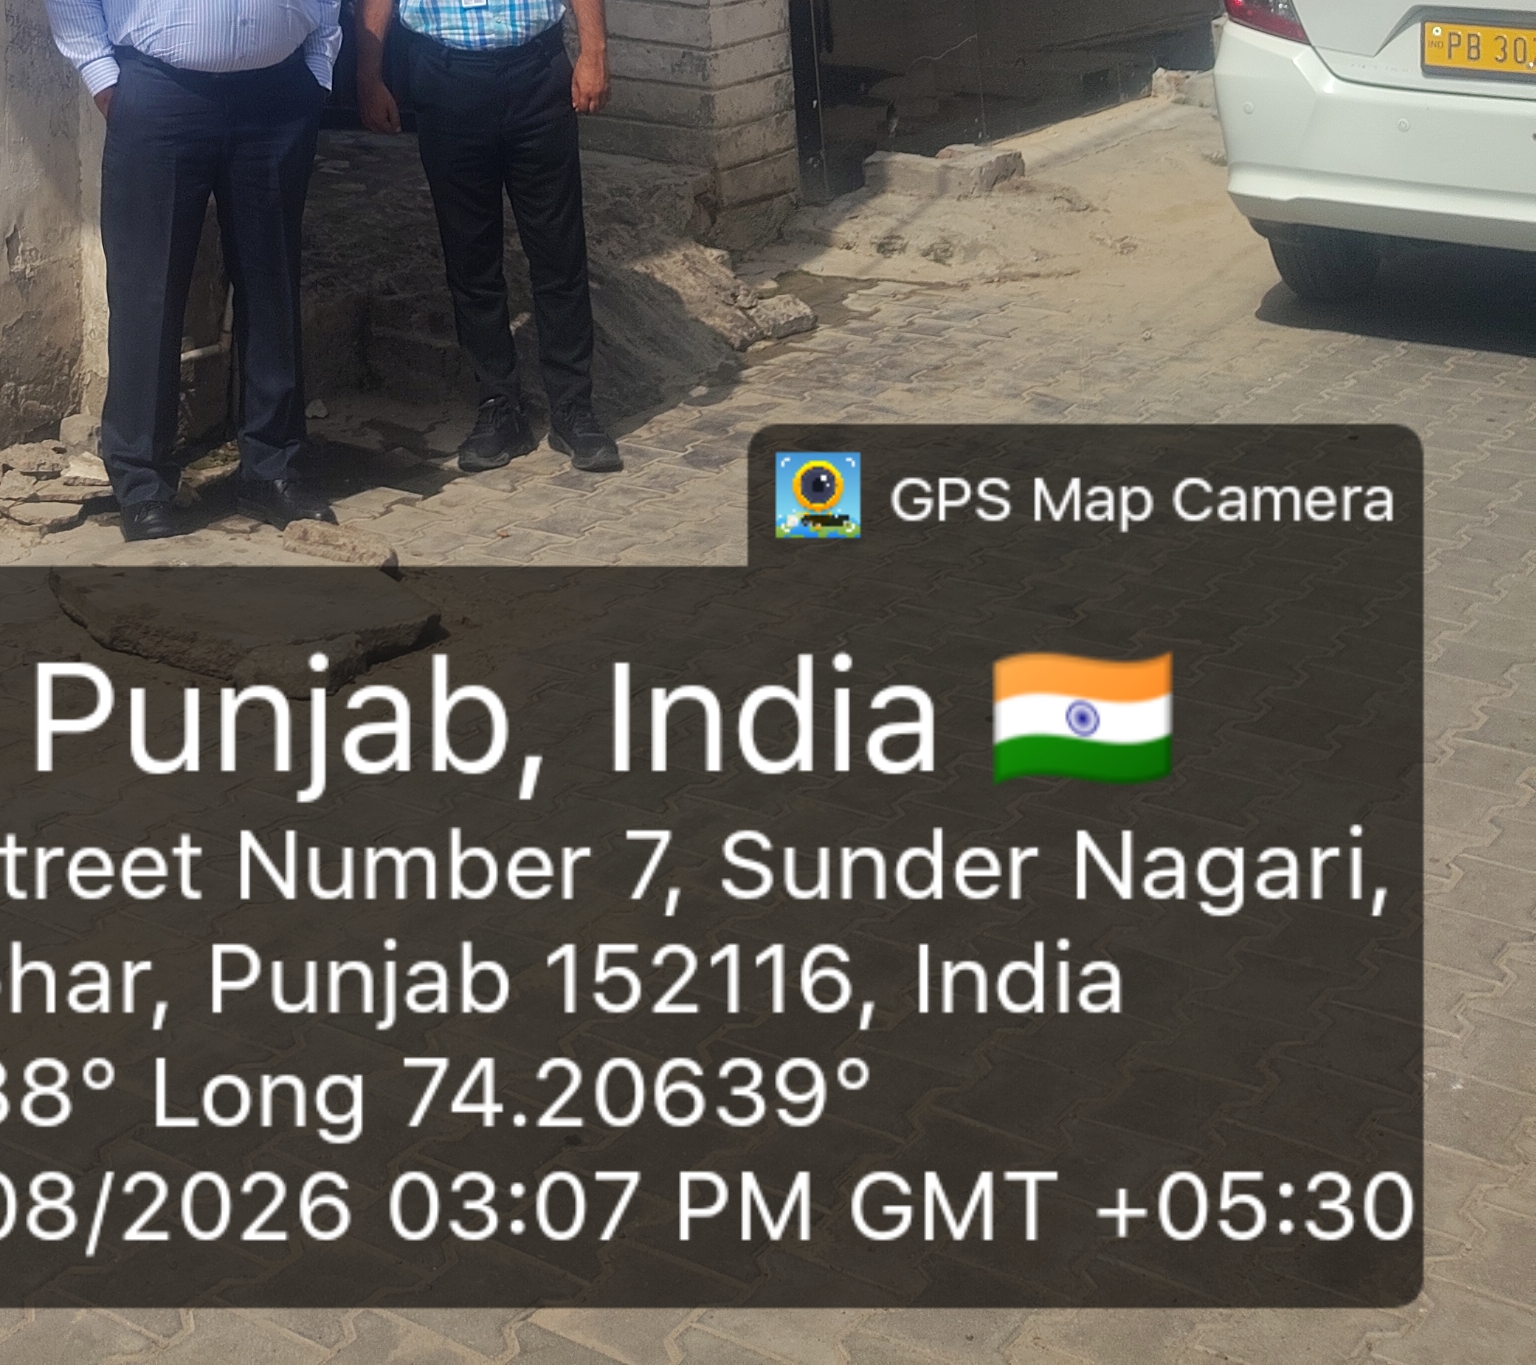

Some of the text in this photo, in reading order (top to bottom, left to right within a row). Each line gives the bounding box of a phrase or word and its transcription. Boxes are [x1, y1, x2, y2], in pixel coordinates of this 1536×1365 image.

[1427, 39, 1444, 49] IND
[1447, 31, 1536, 67] PB 30
